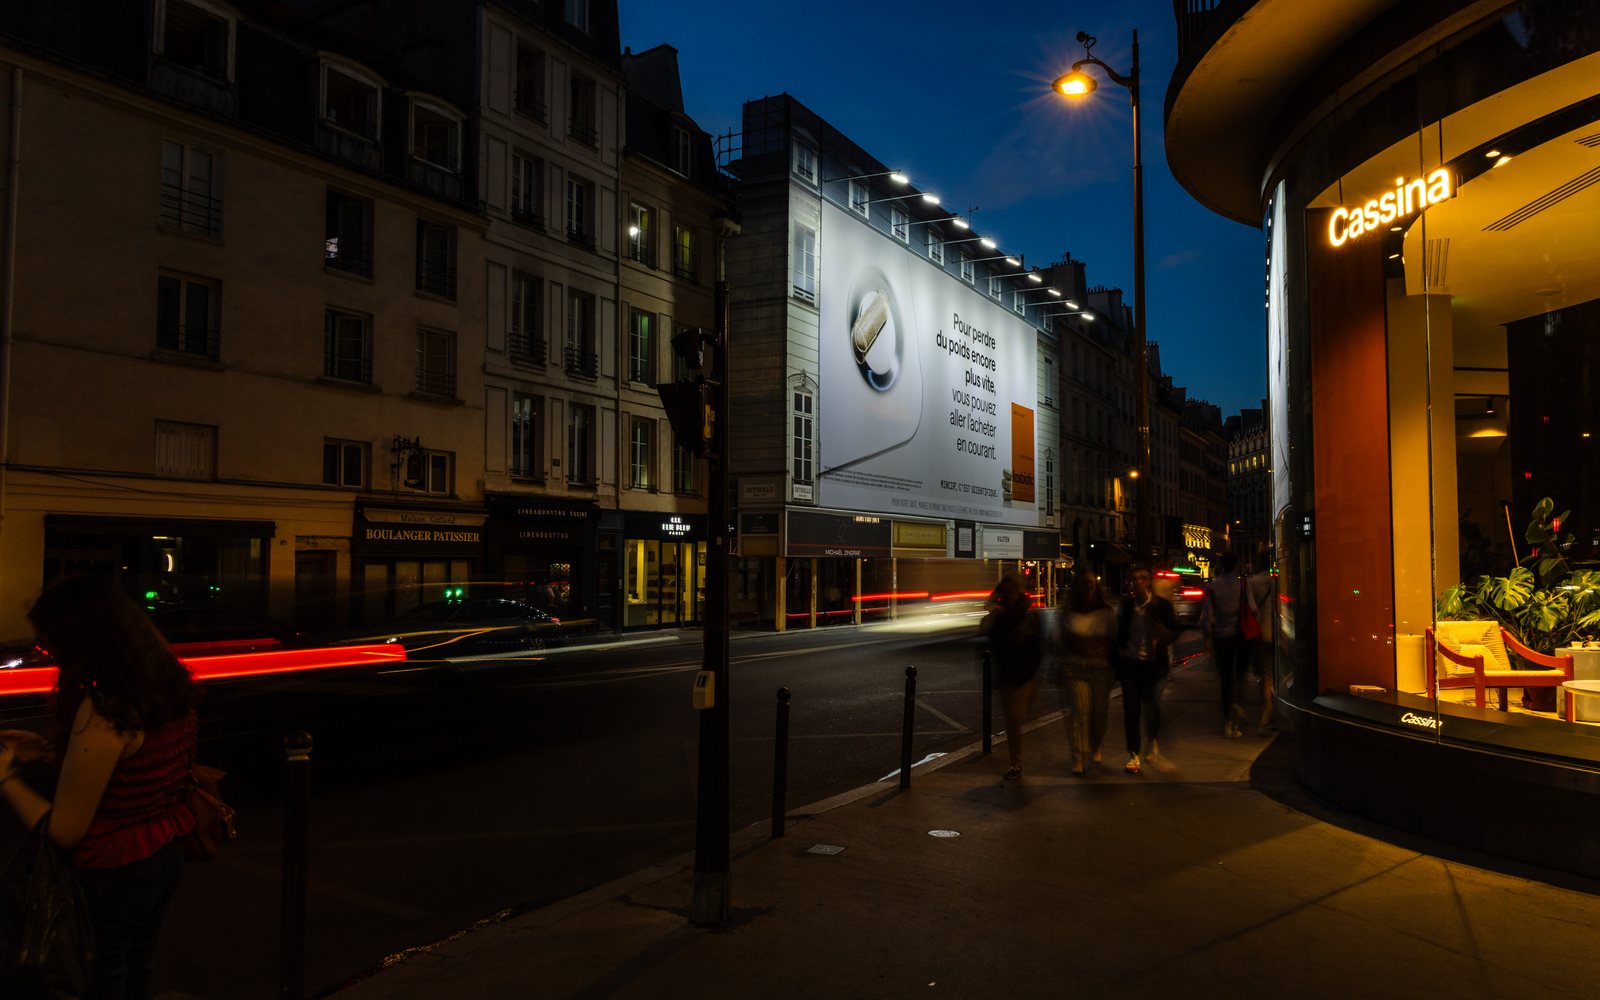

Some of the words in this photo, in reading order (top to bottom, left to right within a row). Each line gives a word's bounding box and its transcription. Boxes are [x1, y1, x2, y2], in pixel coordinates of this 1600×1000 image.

[1328, 169, 1452, 247] Cassina
[953, 312, 971, 337] Pour
[972, 330, 996, 350] perdre
[936, 329, 948, 350] du
[948, 338, 970, 360] poids
[971, 350, 996, 371] encore
[965, 367, 981, 387] plus
[981, 374, 997, 397] vite,
[952, 388, 971, 406] vous
[971, 396, 997, 416] pouvez
[949, 408, 967, 428] aller
[956, 438, 967, 452] en
[967, 441, 997, 460] courant.
[366, 528, 431, 541] BOULANGER
[433, 531, 480, 543] PATISSIER
